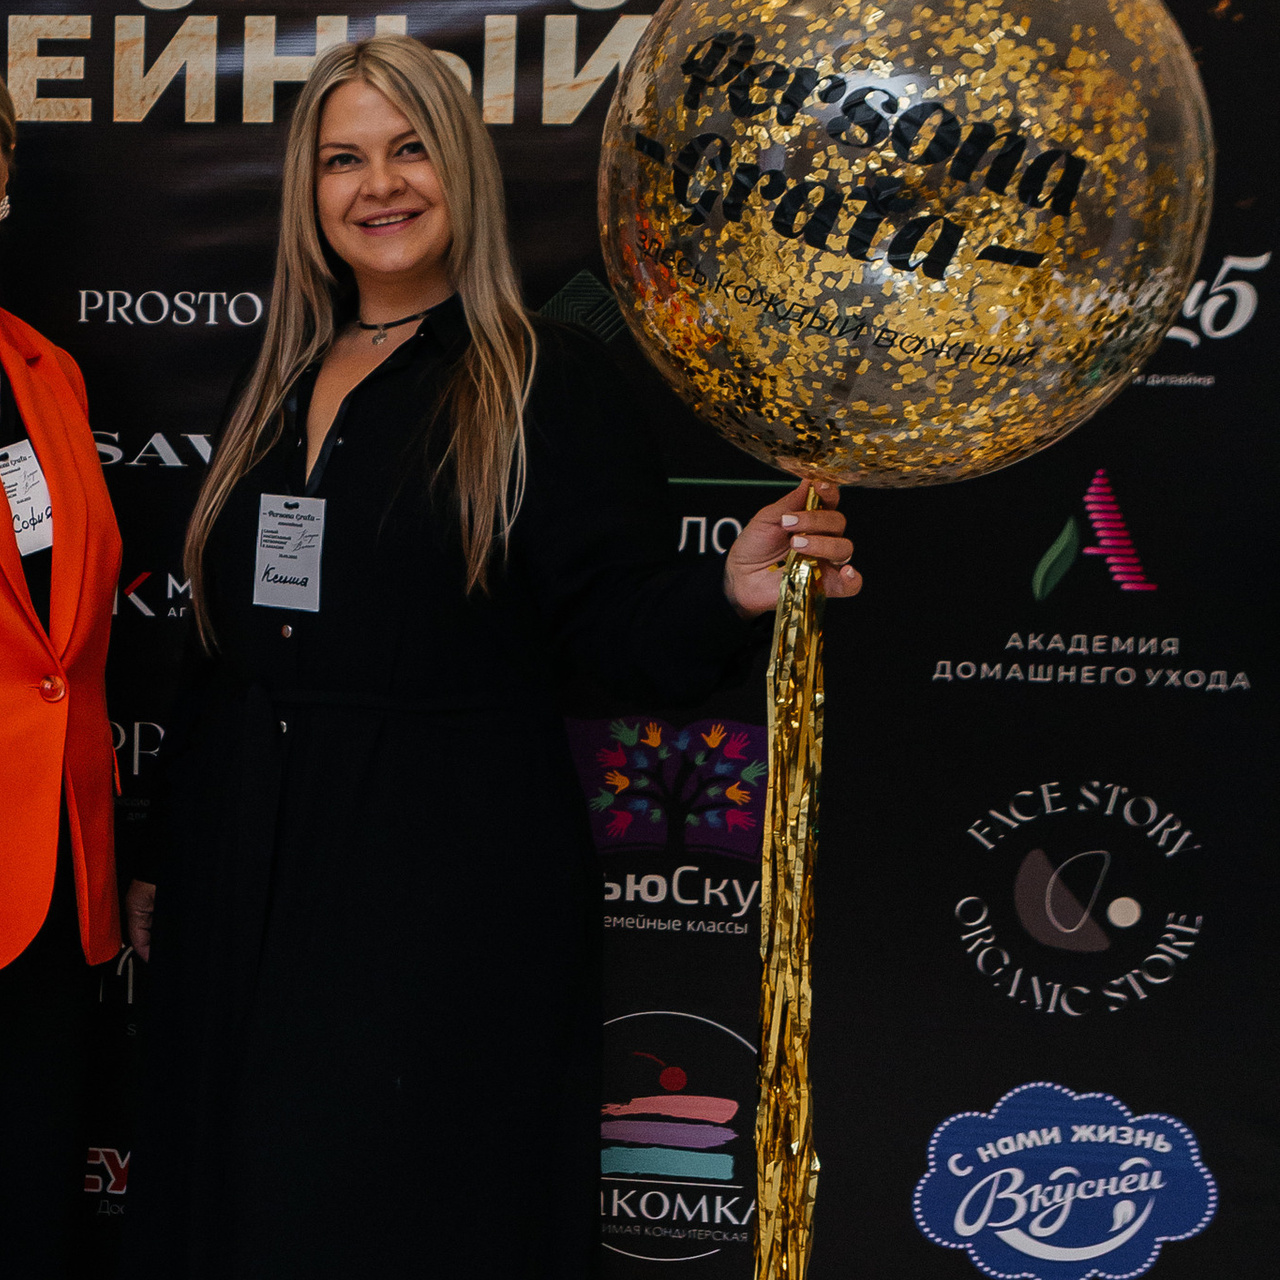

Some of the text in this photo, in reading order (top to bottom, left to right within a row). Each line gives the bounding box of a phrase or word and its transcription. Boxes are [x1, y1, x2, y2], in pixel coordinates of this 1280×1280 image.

[680, 30, 1086, 217] Persona
[77, 289, 264, 327] PROSTO
[1005, 631, 1180, 656] АКАДЕМИЯ
[932, 660, 1252, 694] ДОМАШНЕГО УХОДА
[967, 780, 1203, 858] FACE STORY
[687, 920, 748, 935] классы
[955, 896, 1203, 1017] ORGANIC STORE
